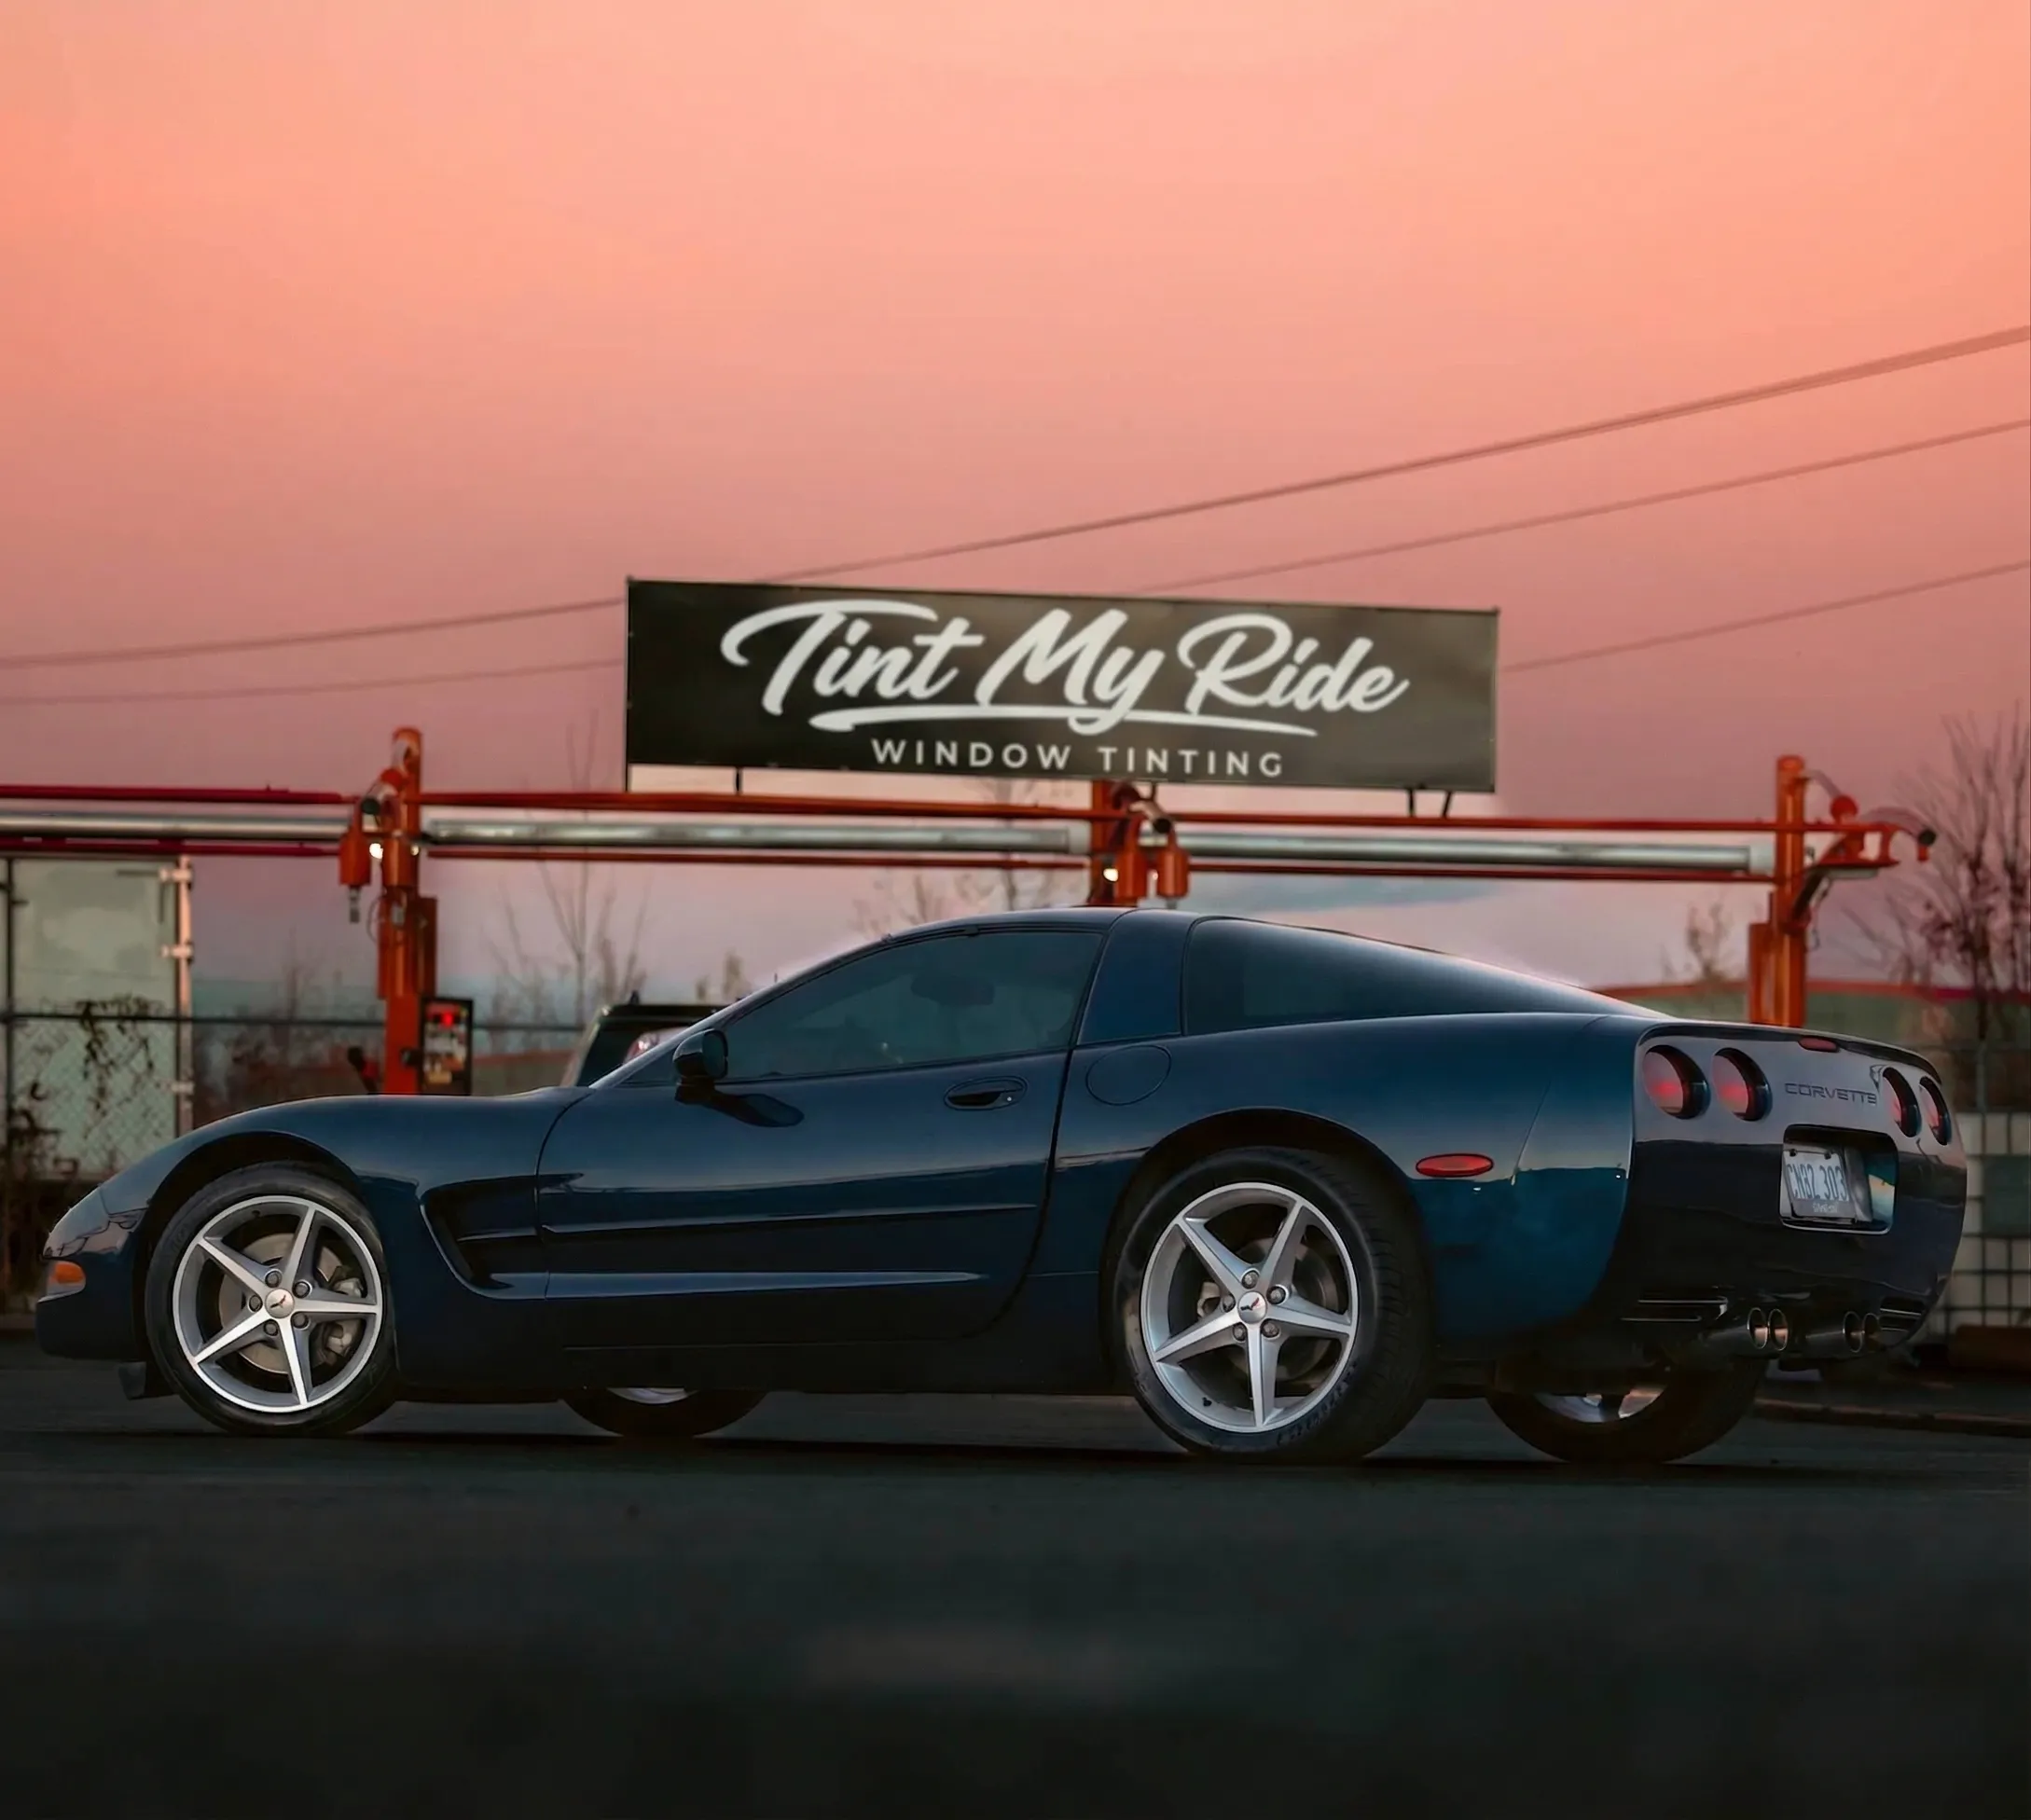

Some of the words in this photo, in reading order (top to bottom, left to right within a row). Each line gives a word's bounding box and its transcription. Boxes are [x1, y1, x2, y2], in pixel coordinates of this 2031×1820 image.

[720, 599, 986, 716] Tint
[974, 608, 1165, 736] My
[1176, 613, 1411, 715] Ride
[871, 738, 1071, 769] WINDOW
[1098, 746, 1283, 777] TINTING
[1784, 1082, 1877, 1104] CORVETTE
